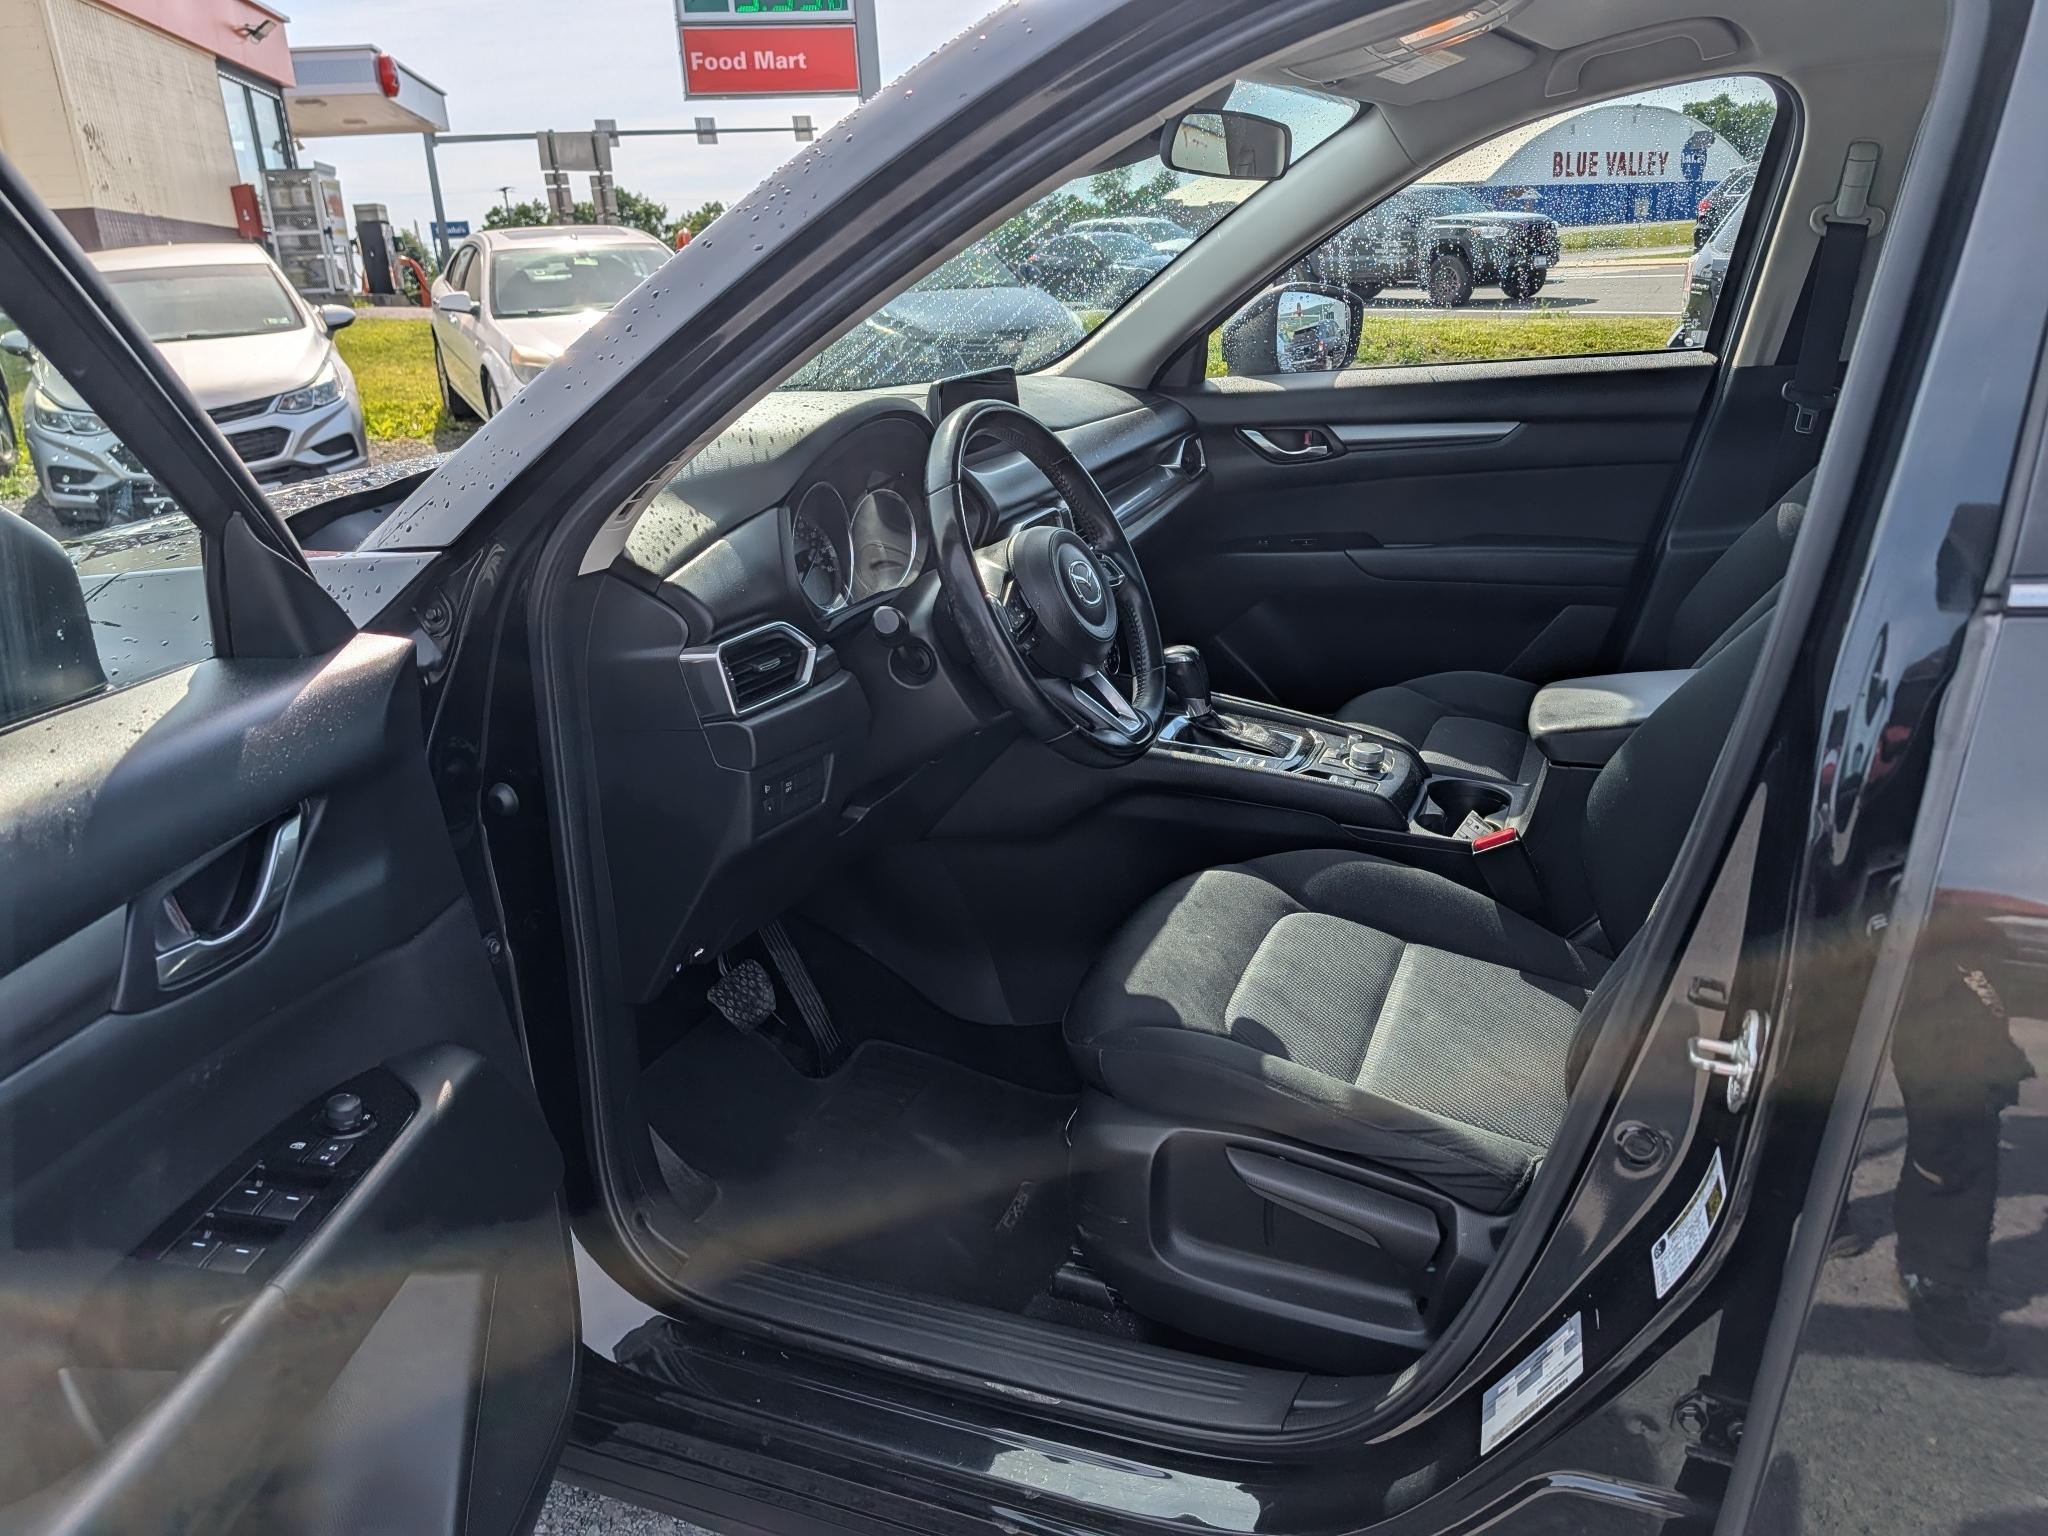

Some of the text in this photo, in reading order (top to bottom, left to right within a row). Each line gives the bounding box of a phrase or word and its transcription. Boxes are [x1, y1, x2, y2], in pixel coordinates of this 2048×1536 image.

[690, 50, 807, 71] Food Mart
[1552, 151, 1599, 178] BLUE
[1605, 151, 1670, 177] VALLEY
